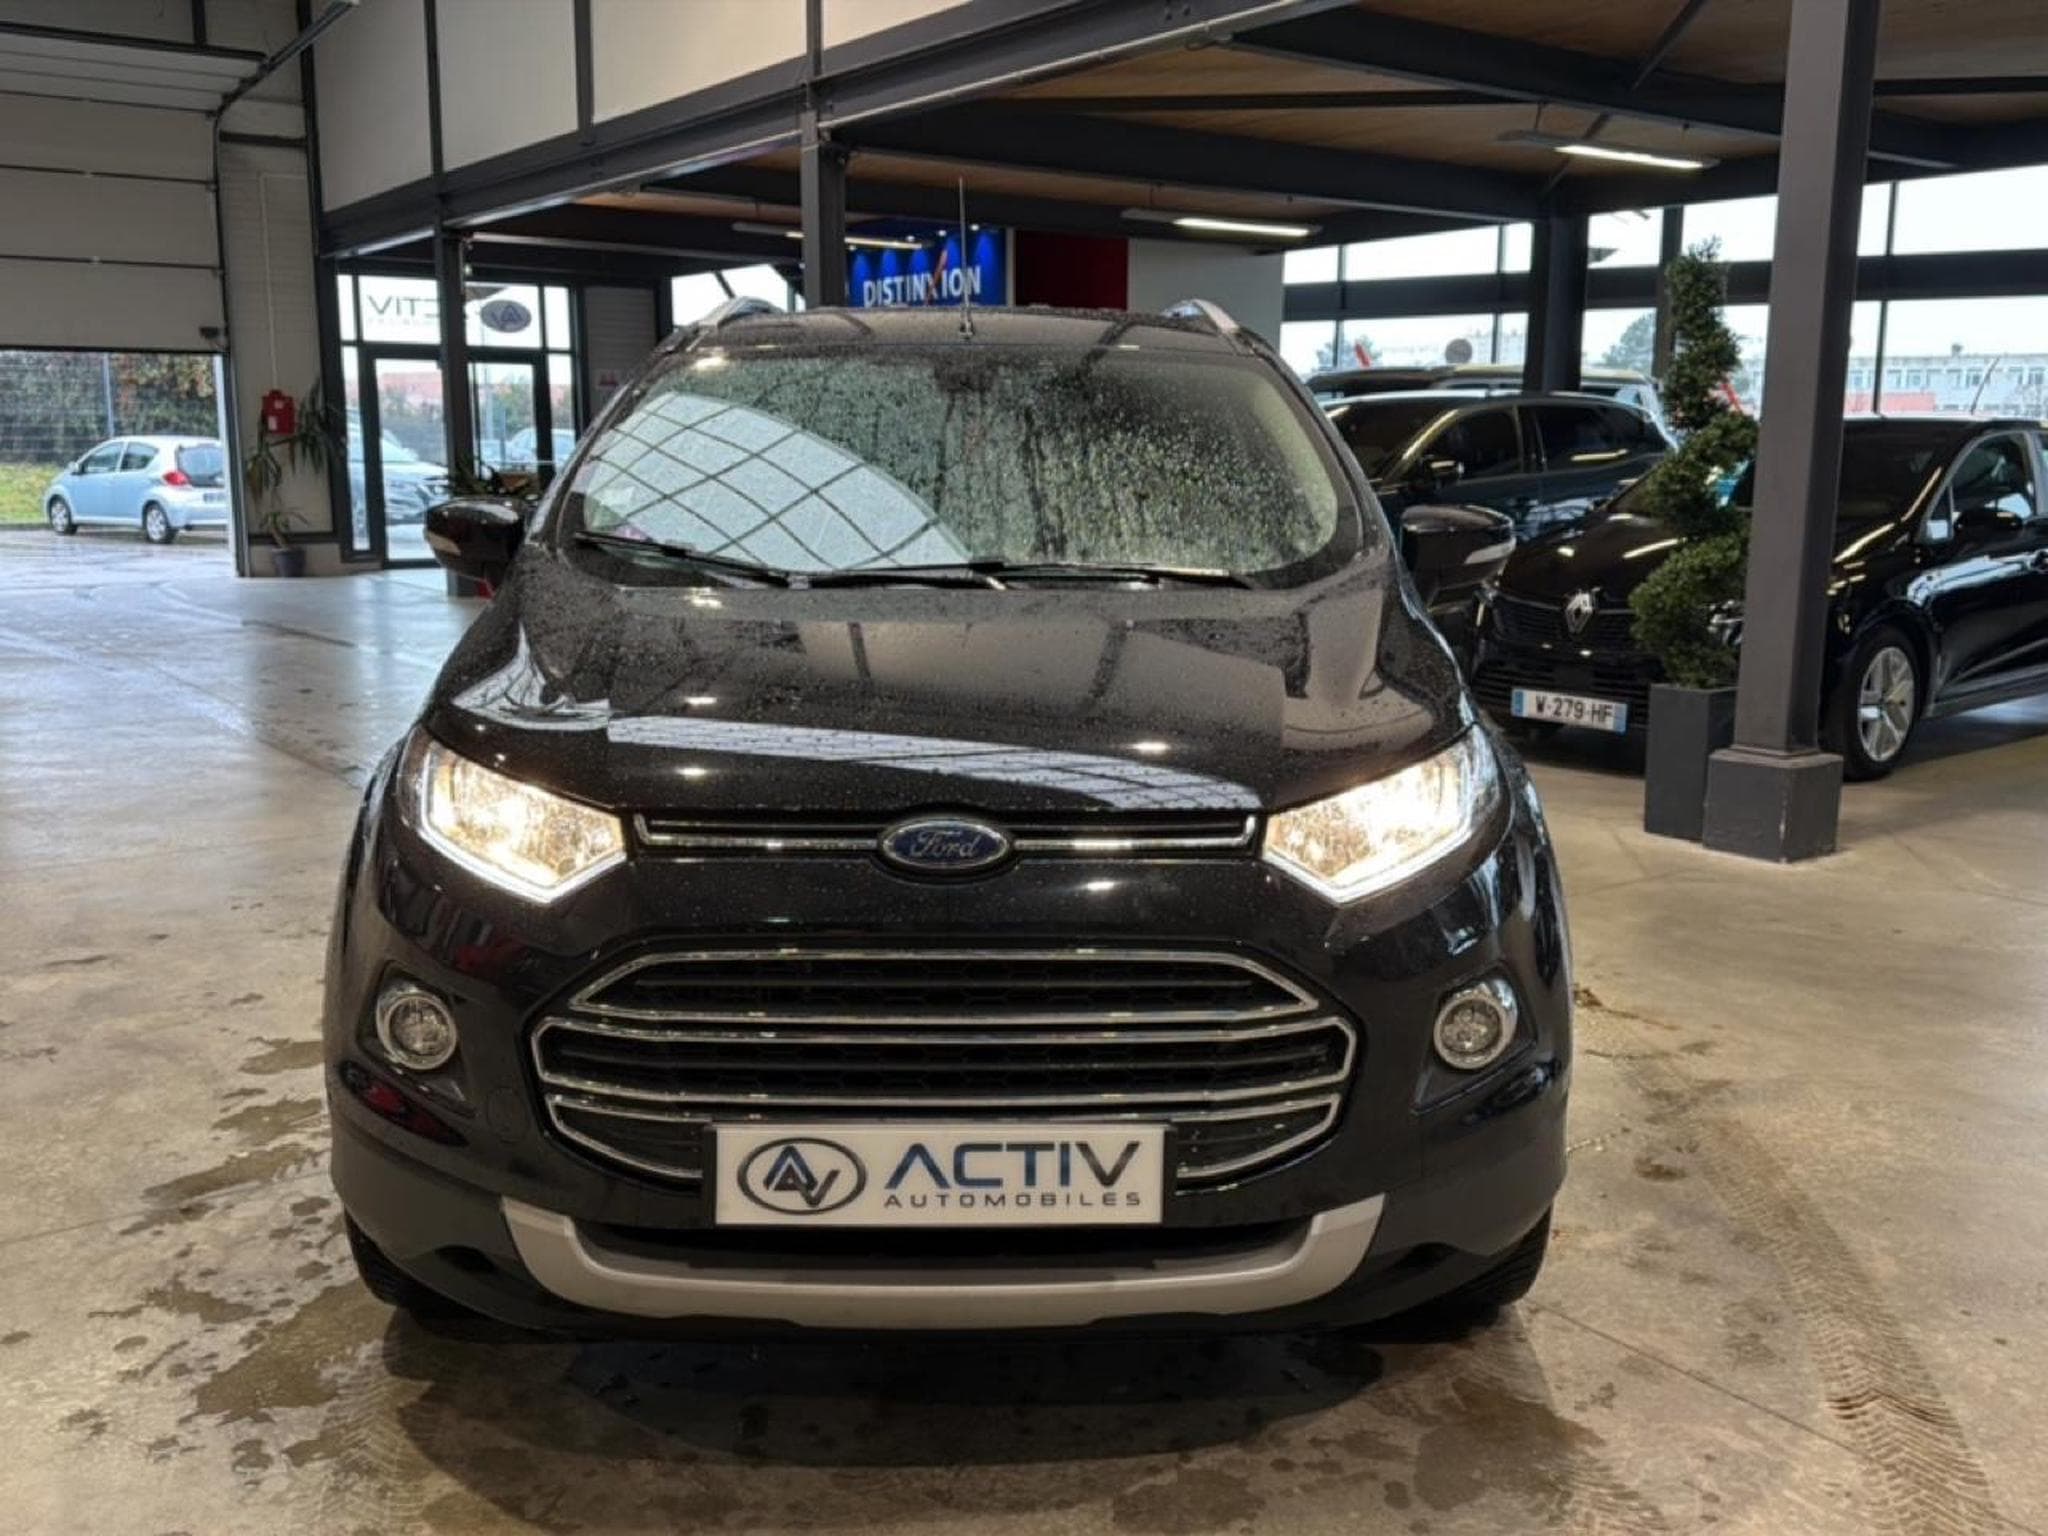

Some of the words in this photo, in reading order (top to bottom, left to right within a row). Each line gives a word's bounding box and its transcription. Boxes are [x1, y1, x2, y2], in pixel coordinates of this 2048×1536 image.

[909, 830, 982, 858] Ford
[884, 1141, 1141, 1190] ACTIV
[883, 1192, 1141, 1209] AUTOMOBILES
